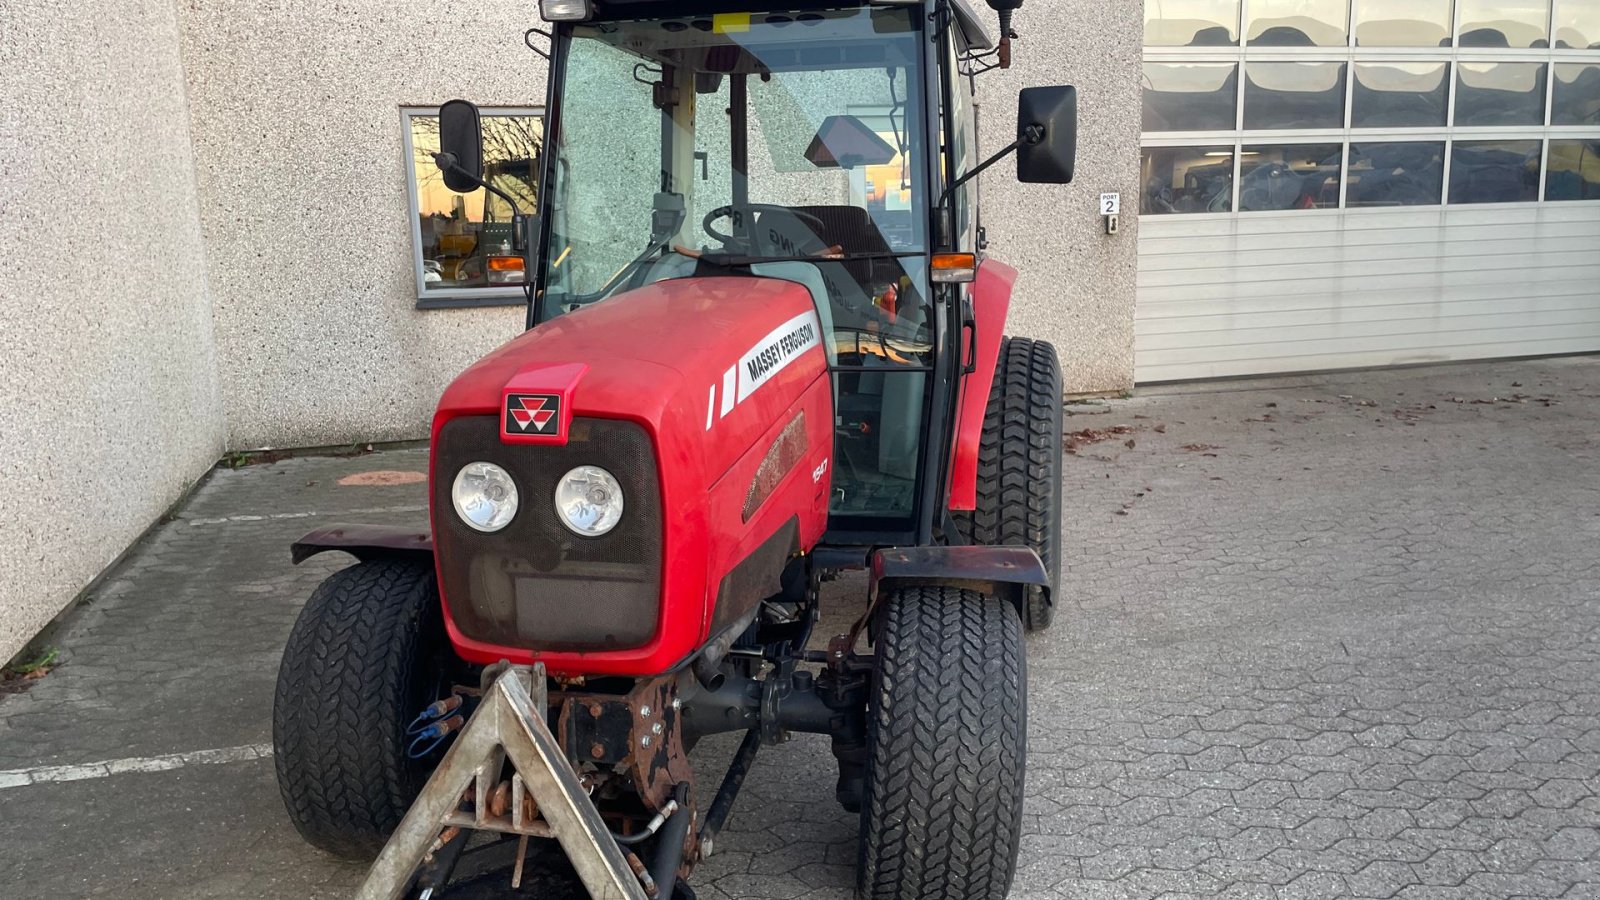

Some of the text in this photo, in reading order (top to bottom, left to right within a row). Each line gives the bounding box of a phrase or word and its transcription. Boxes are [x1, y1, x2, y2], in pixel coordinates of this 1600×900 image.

[1106, 201, 1114, 212] 2
[747, 323, 814, 382] MASSEY FERGUSON
